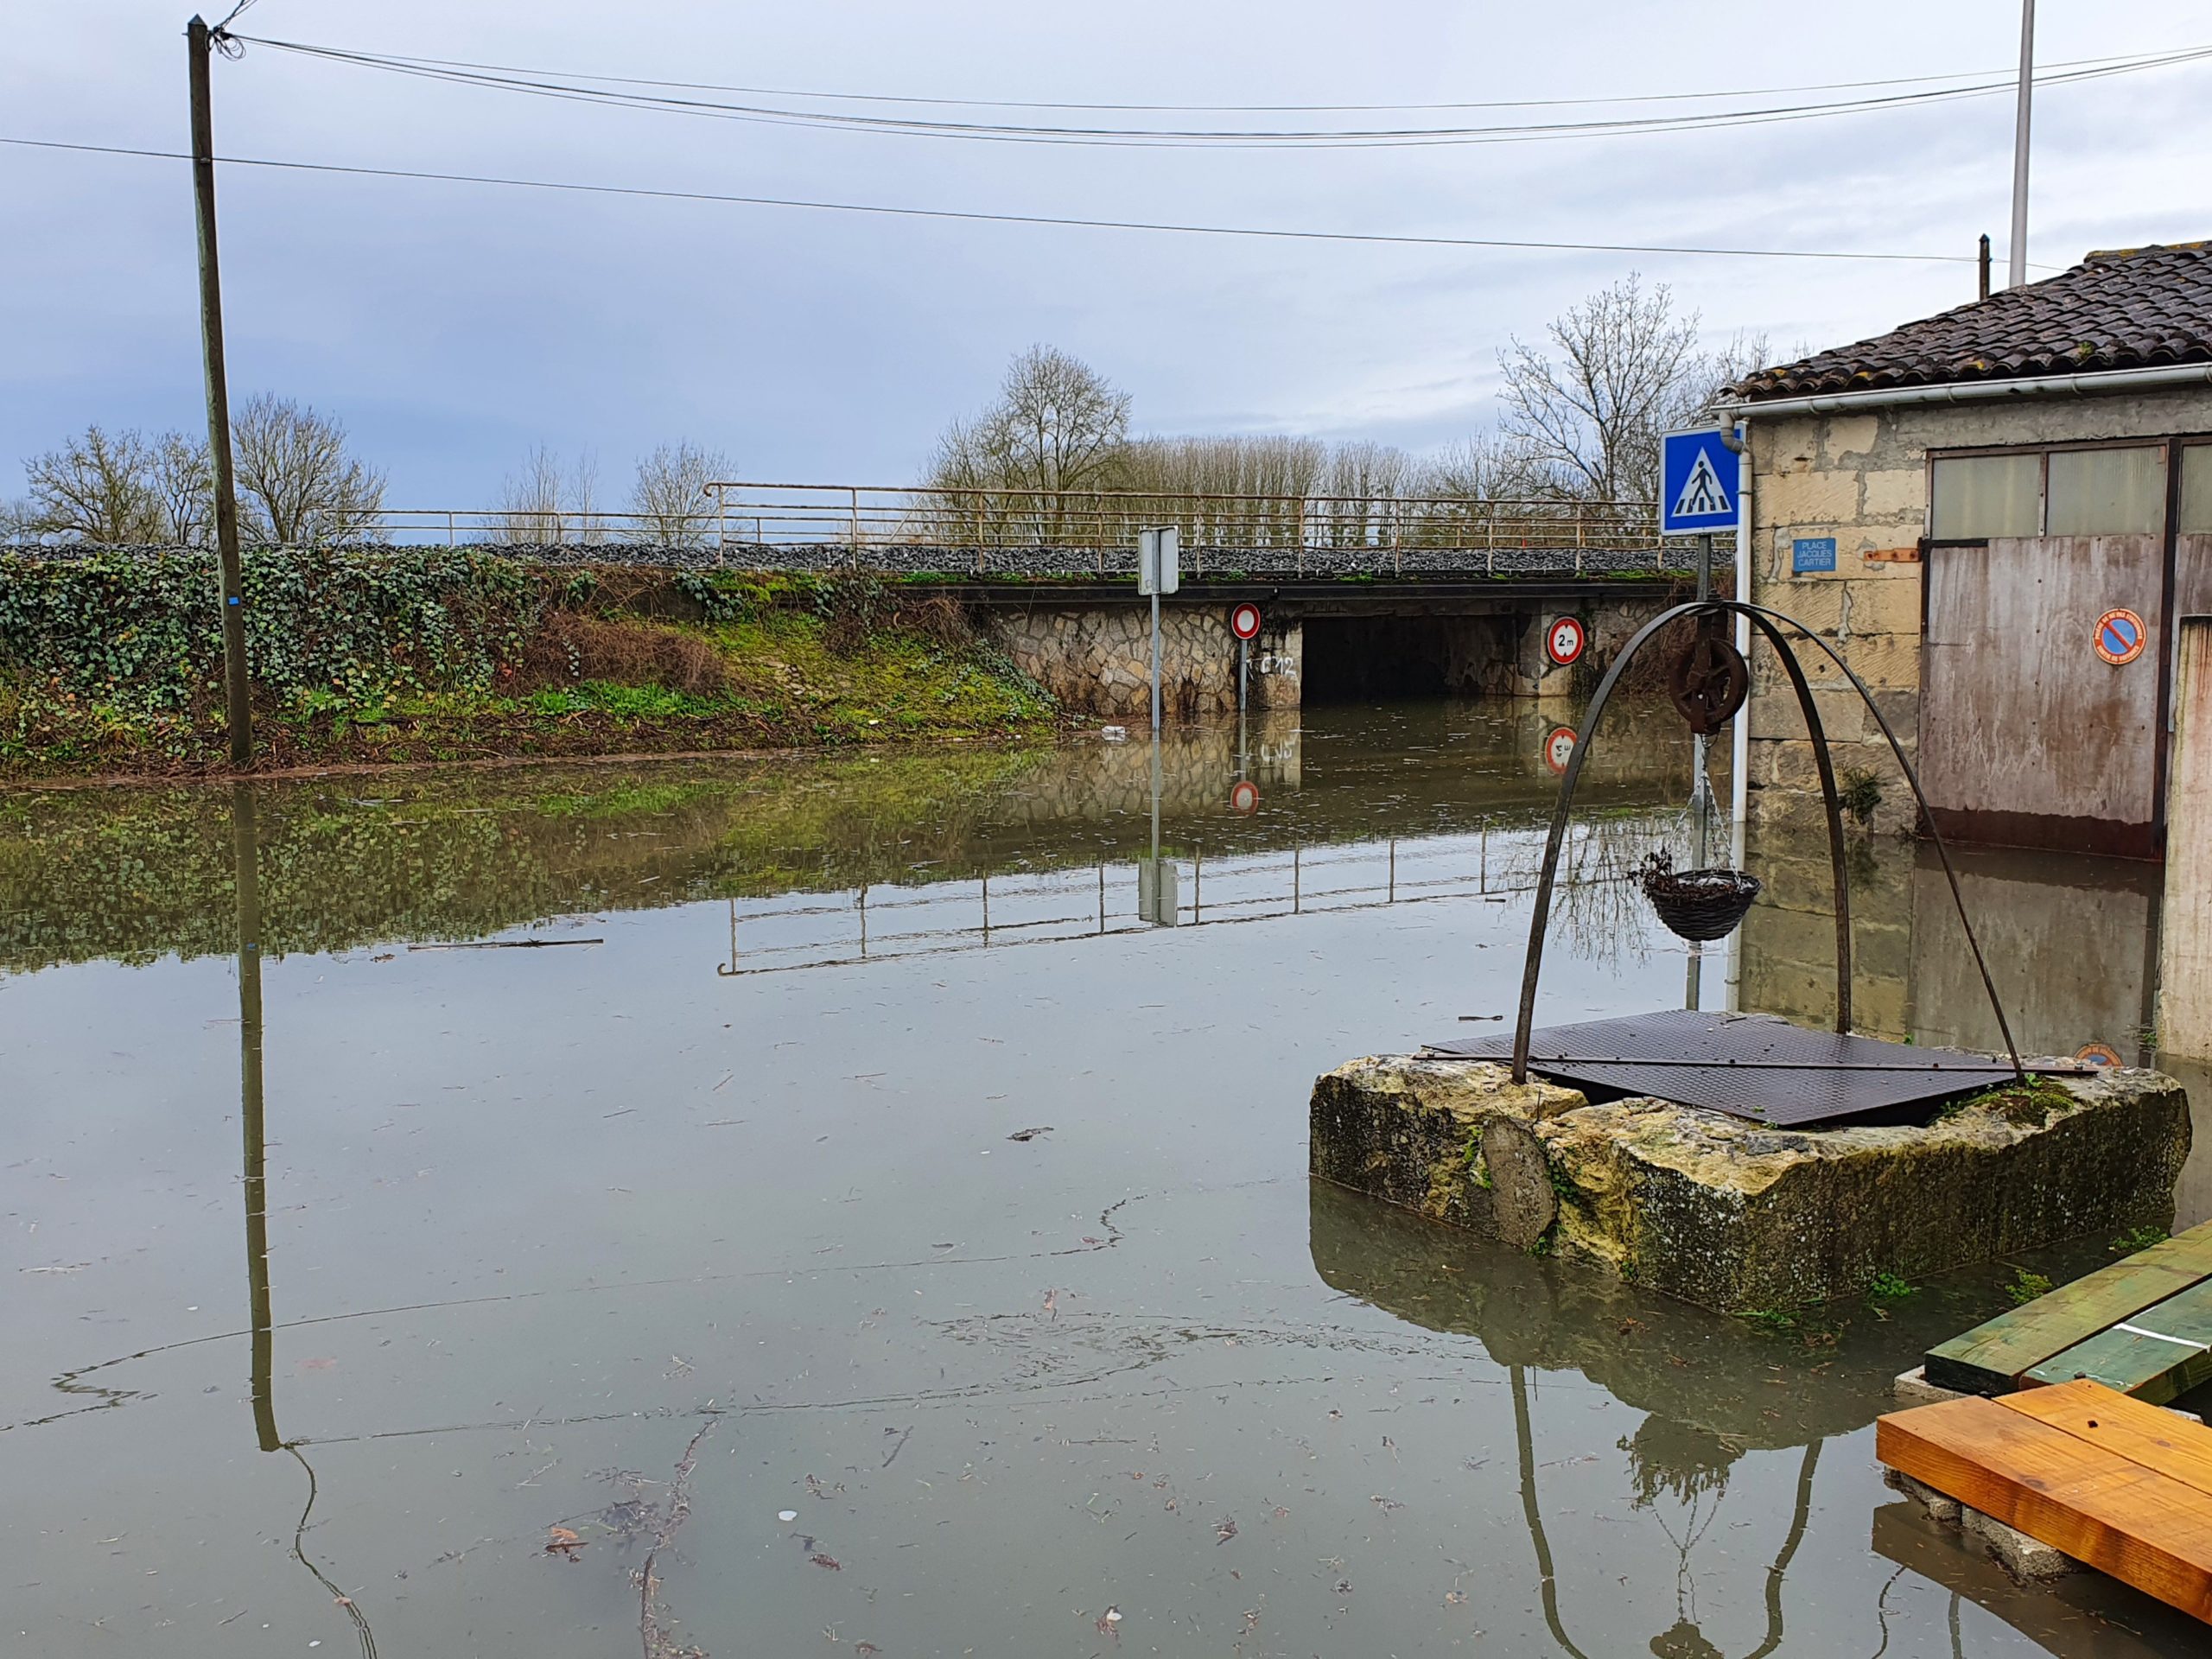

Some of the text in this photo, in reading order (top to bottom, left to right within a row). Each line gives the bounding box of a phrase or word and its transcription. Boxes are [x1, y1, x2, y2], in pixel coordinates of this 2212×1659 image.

[1802, 541, 1827, 550] PLACE
[1797, 549, 1833, 558] JACQUES
[1798, 557, 1832, 567] CARTIER
[1558, 634, 1566, 646] 2
